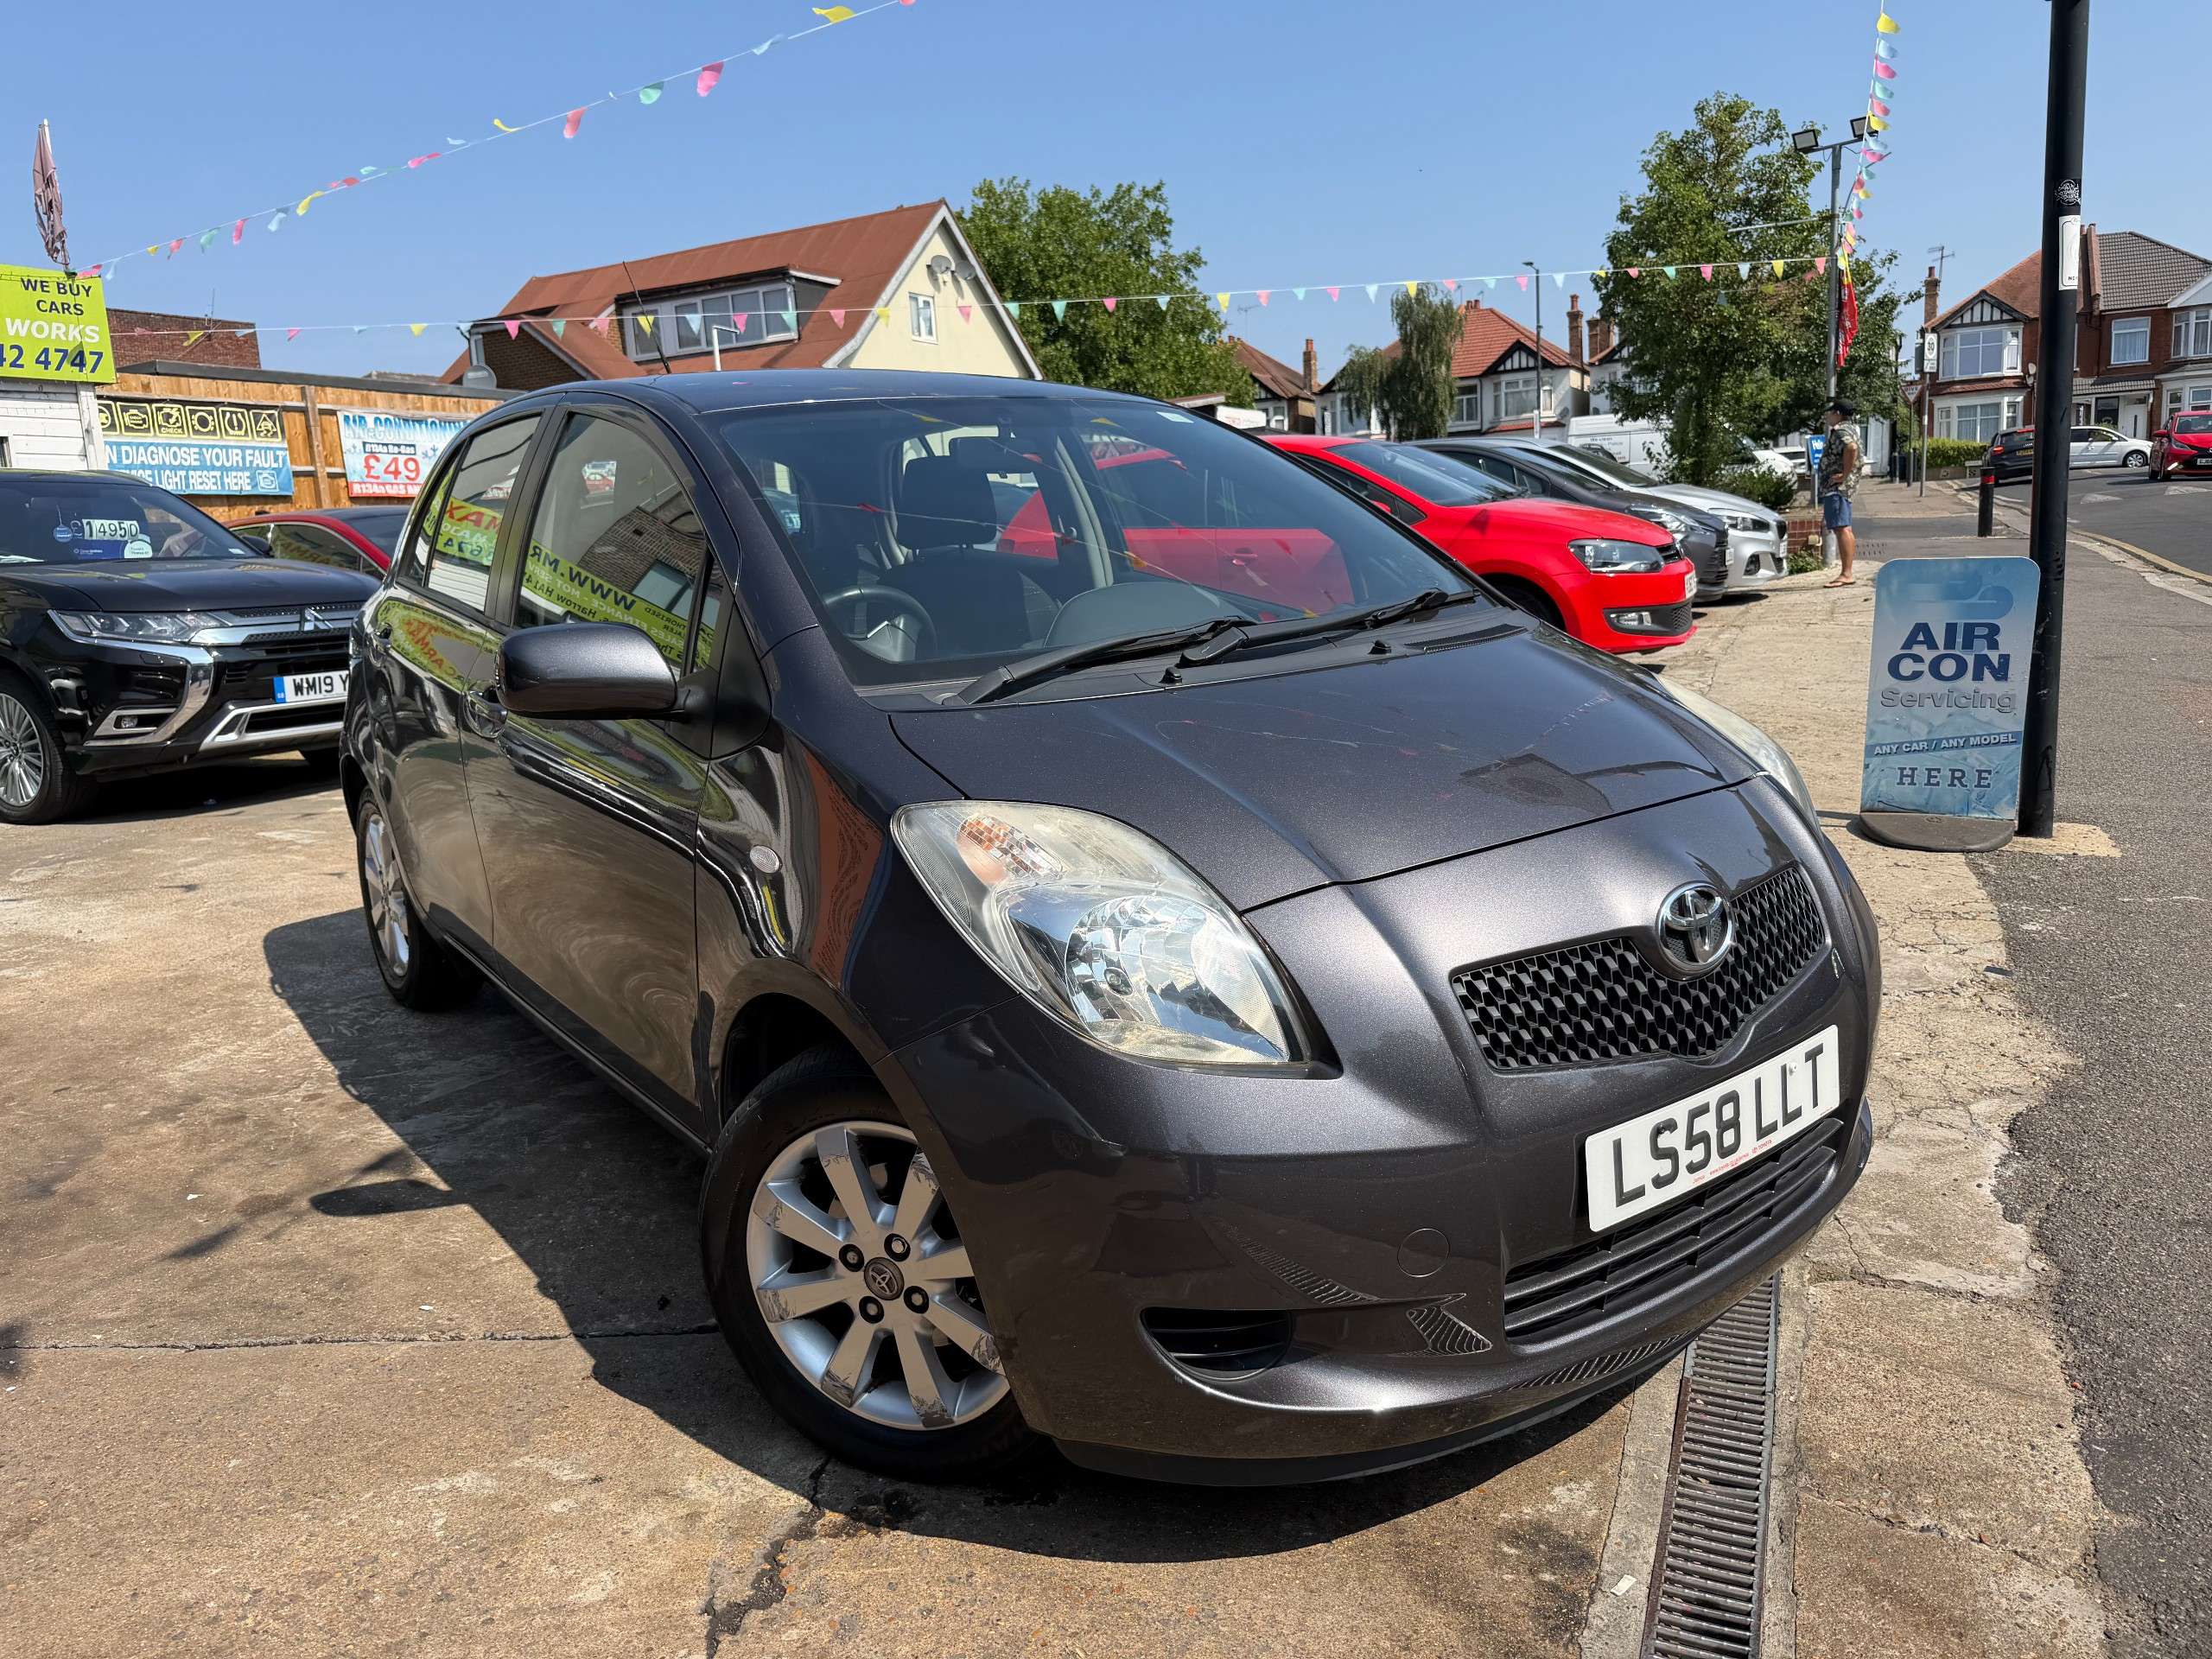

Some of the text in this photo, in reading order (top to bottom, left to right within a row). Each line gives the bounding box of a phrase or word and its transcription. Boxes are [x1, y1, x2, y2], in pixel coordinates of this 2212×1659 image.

[21, 277, 92, 297] WE BUY
[36, 300, 84, 316] CARS
[6, 318, 99, 343] WORKS
[1927, 342, 1935, 351] 30
[35, 347, 103, 374] 4747
[122, 446, 200, 467] DIAGNOSE
[203, 448, 243, 467] YOUR
[245, 450, 284, 468] FAULT
[363, 454, 421, 481] £49
[156, 469, 186, 490] LIGHT
[188, 470, 221, 491] RESET
[225, 471, 251, 491] HERE
[1899, 622, 2001, 650] AIR
[1887, 652, 2011, 682] CON
[293, 676, 334, 696] WM19
[1880, 688, 2018, 714] Servicing
[1873, 744, 1899, 756] ANY
[1902, 740, 1929, 753] CAR
[1941, 736, 1966, 749] ANY
[1969, 733, 2018, 746] MODEL
[1896, 766, 1993, 789] HERE
[1612, 1043, 1824, 1208] LS58 LLT
